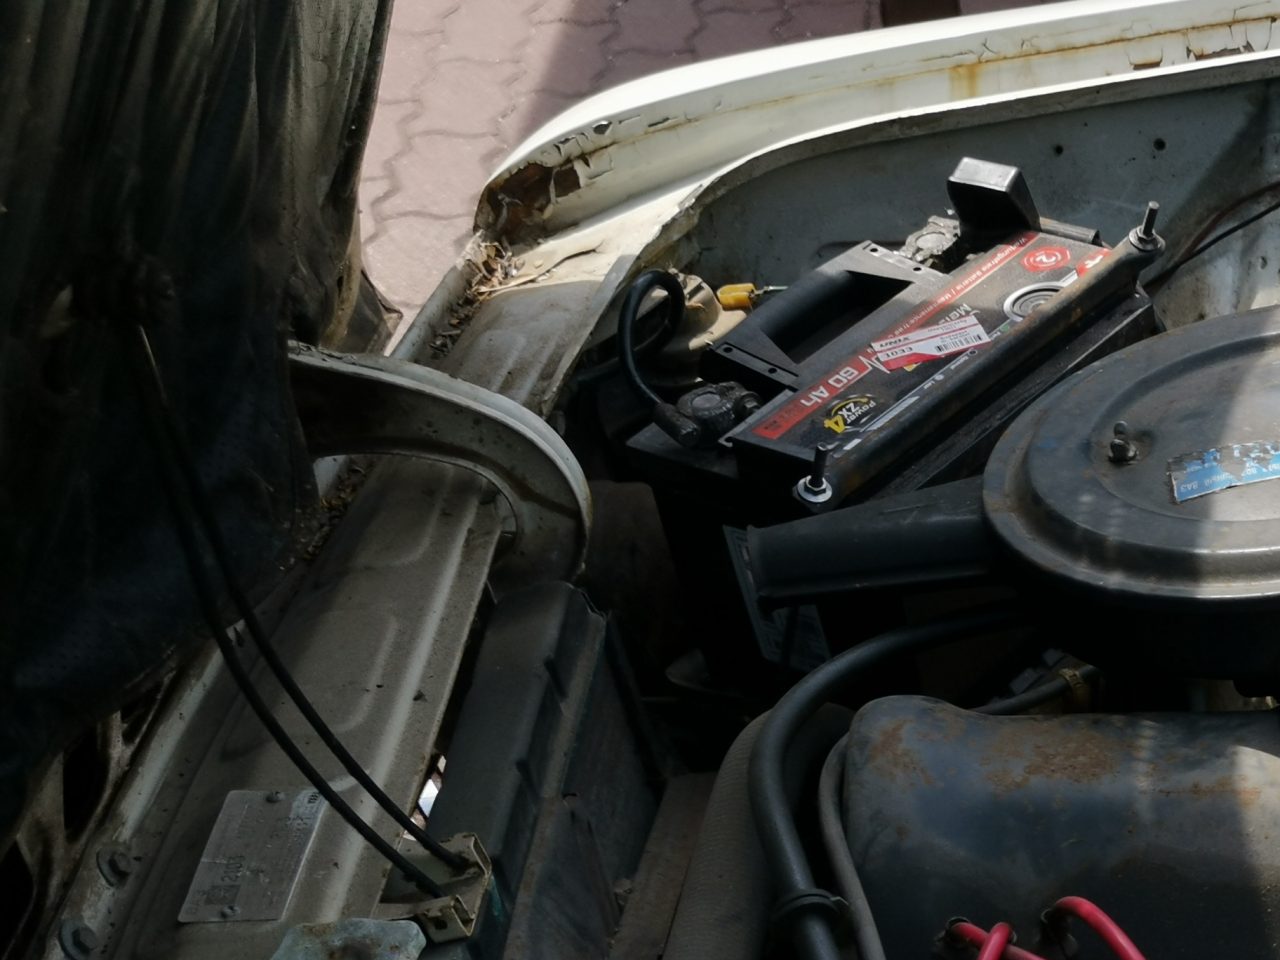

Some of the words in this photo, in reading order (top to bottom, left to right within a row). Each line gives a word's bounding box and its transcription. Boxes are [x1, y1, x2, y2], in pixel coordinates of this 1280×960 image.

[826, 365, 859, 389] 60
[799, 384, 830, 406] Ah
[845, 399, 876, 424] Power
